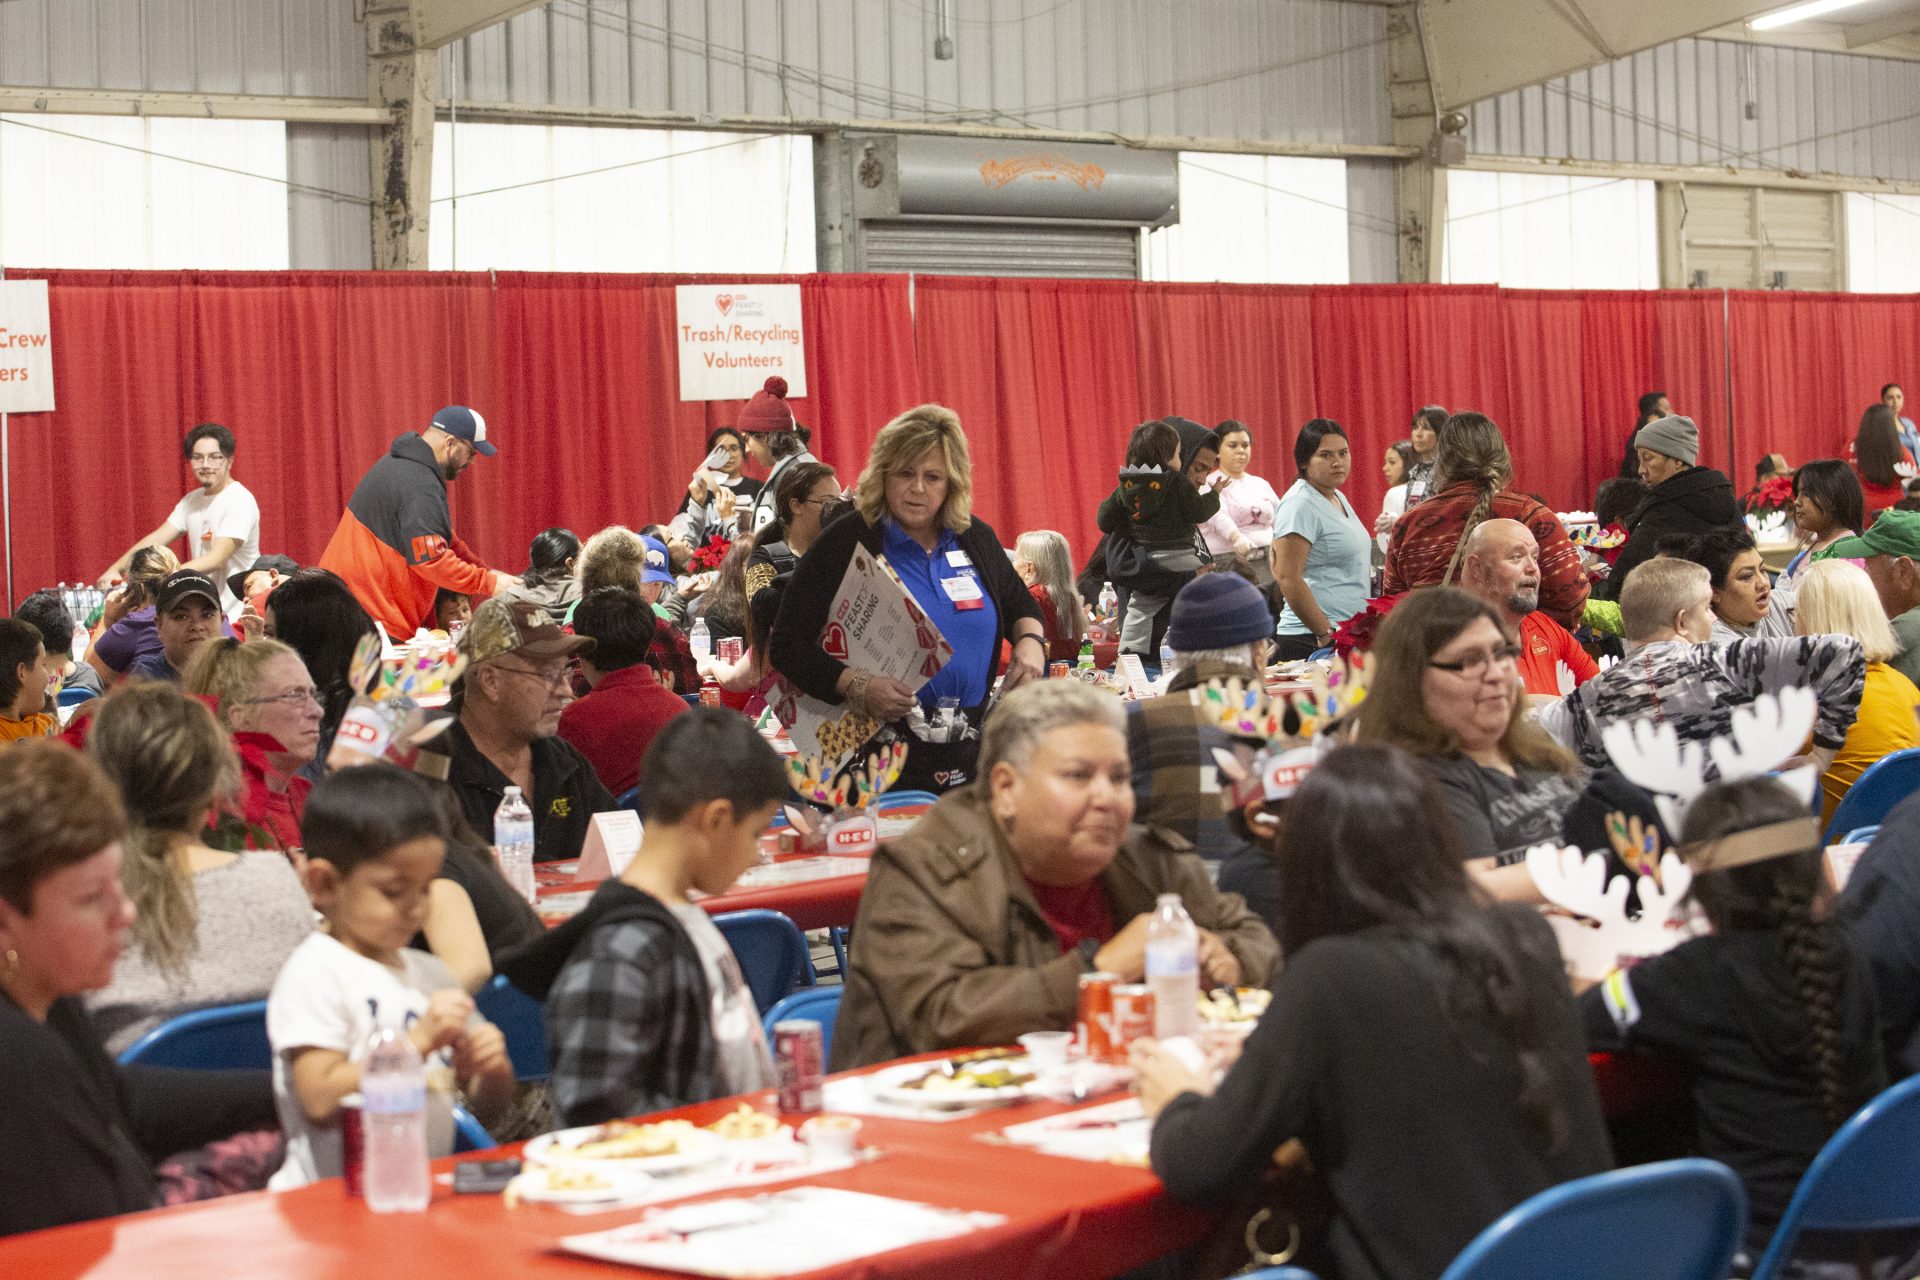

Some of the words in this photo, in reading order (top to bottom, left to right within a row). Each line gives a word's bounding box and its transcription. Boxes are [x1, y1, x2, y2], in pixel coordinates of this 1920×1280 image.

[682, 324, 799, 345] Trash/Recycling
[703, 351, 783, 368] Volunteers
[844, 594, 863, 632] FEAST
[852, 593, 879, 641] SHARING
